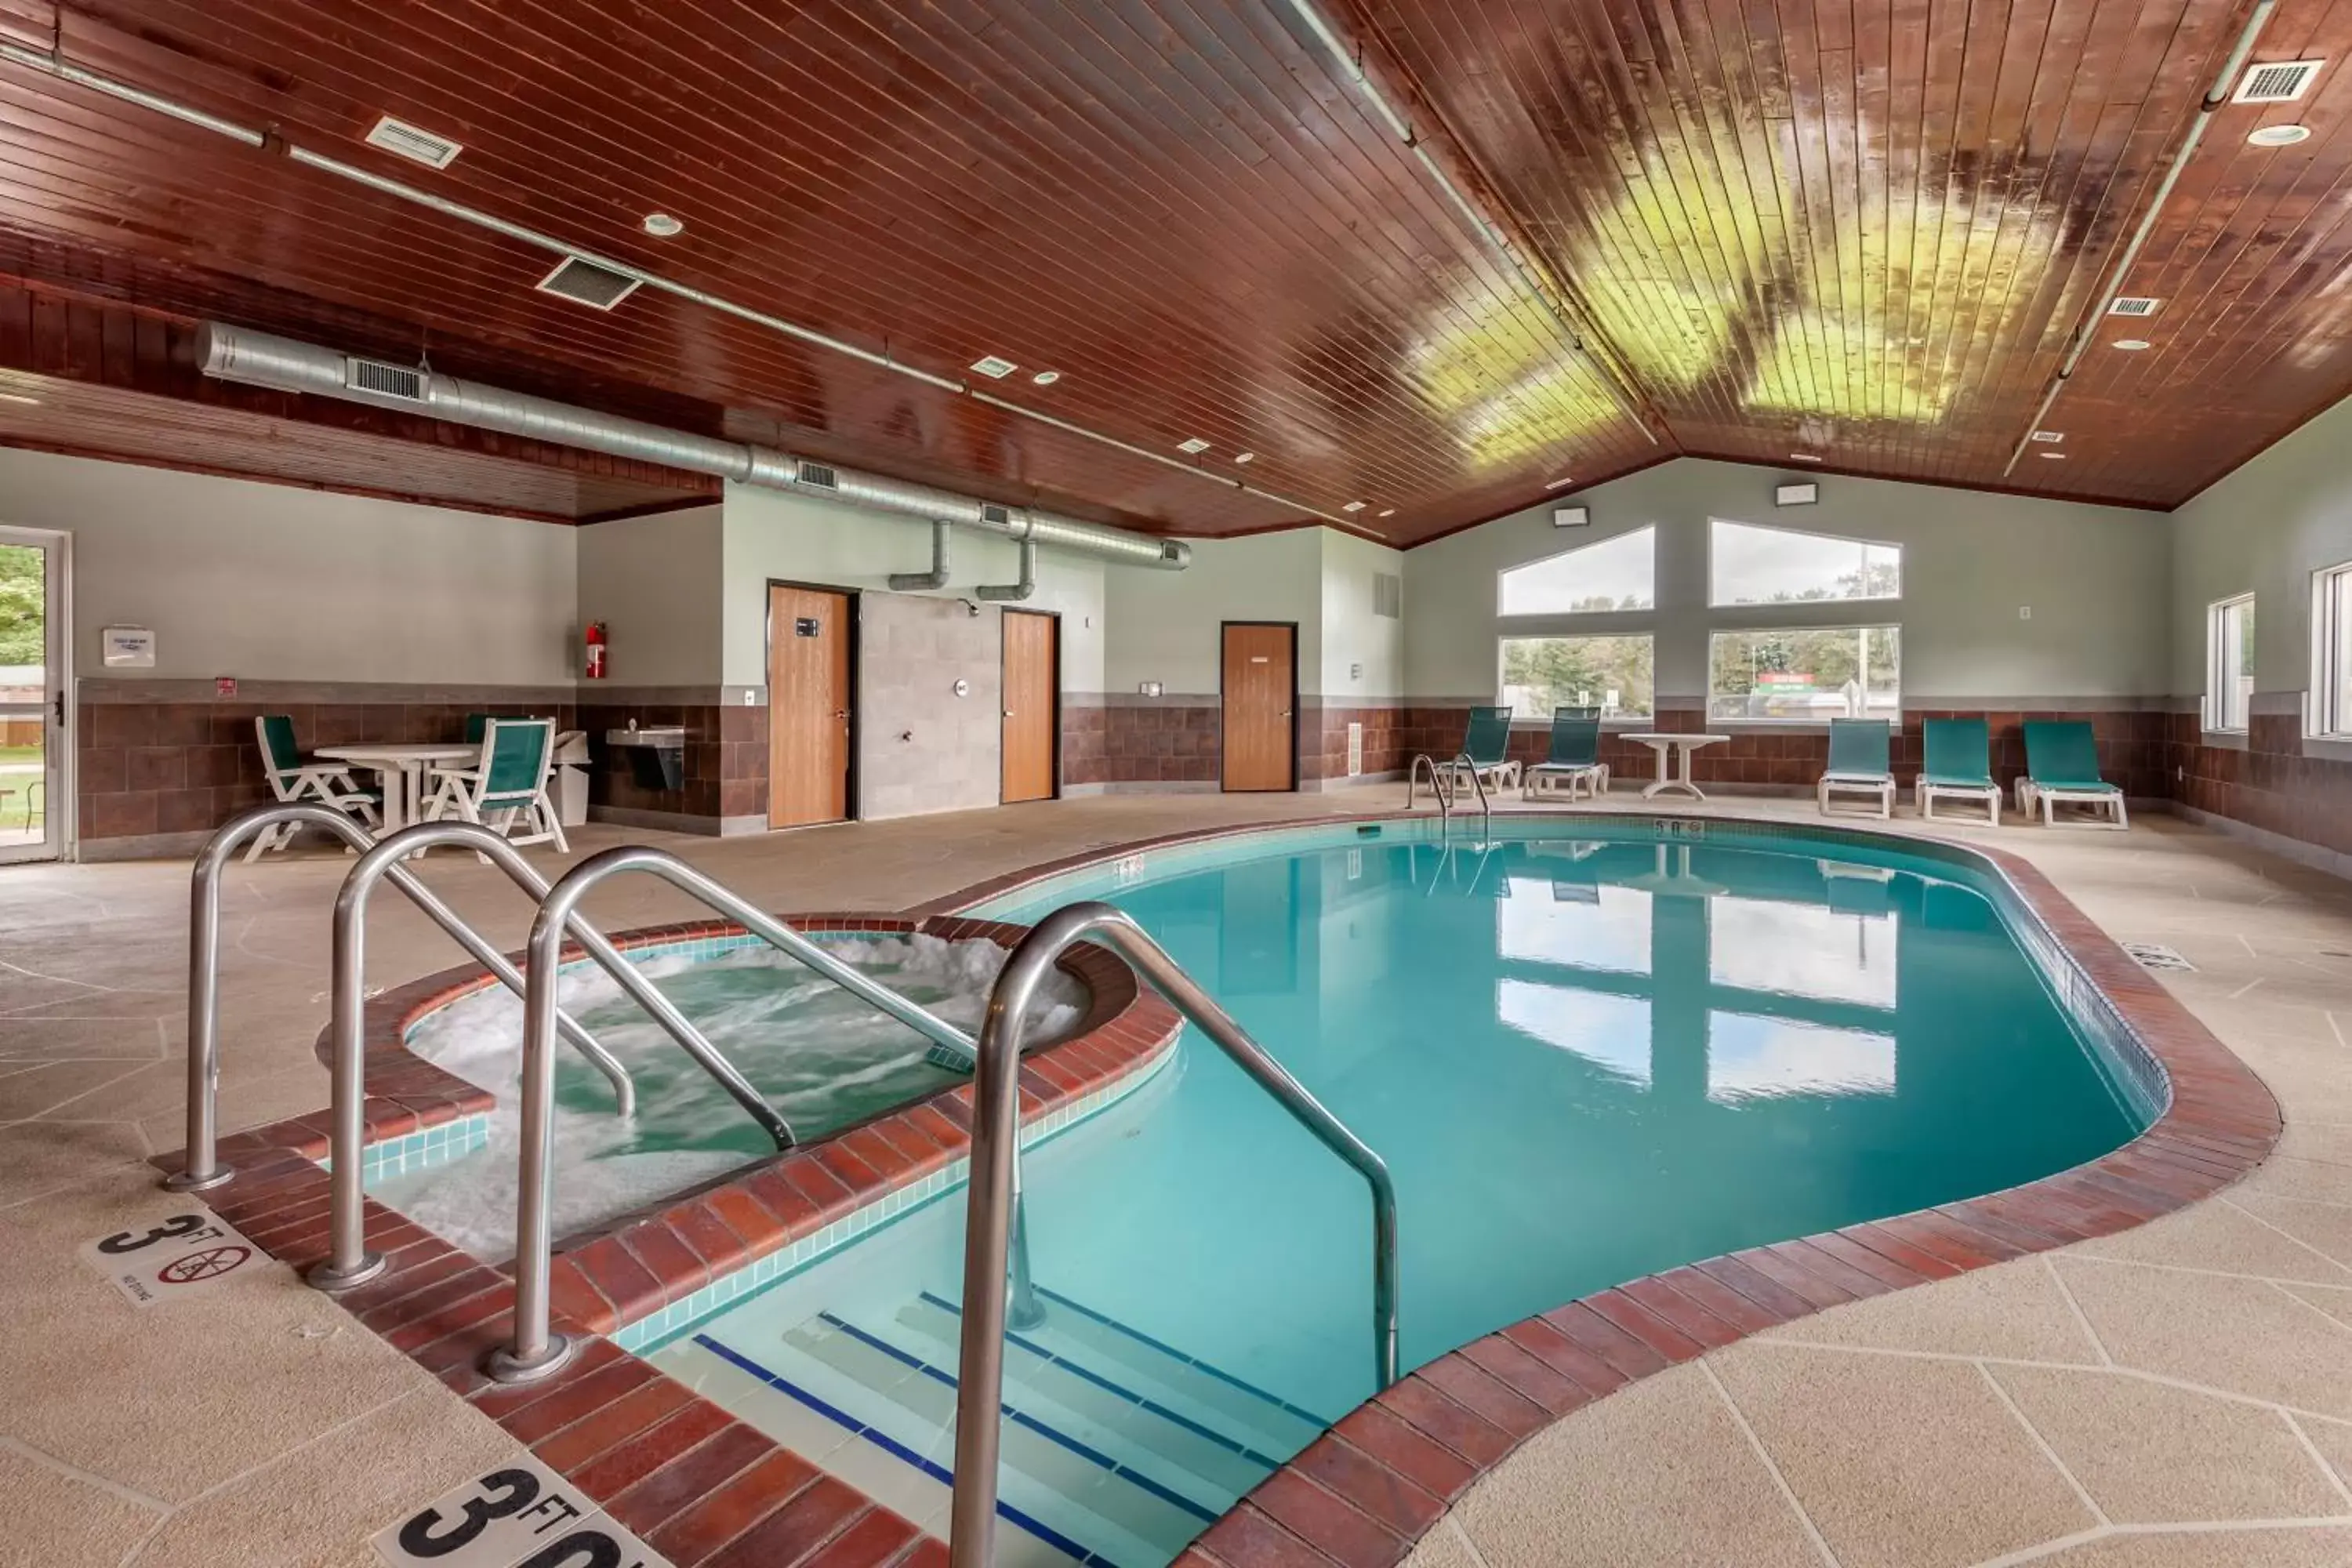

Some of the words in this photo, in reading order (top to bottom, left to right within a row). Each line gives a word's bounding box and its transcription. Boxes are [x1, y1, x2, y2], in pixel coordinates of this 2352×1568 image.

[97, 1214, 205, 1254] 3
[182, 1226, 225, 1244] FT
[398, 1468, 540, 1558] 3
[517, 1494, 582, 1534] FT
